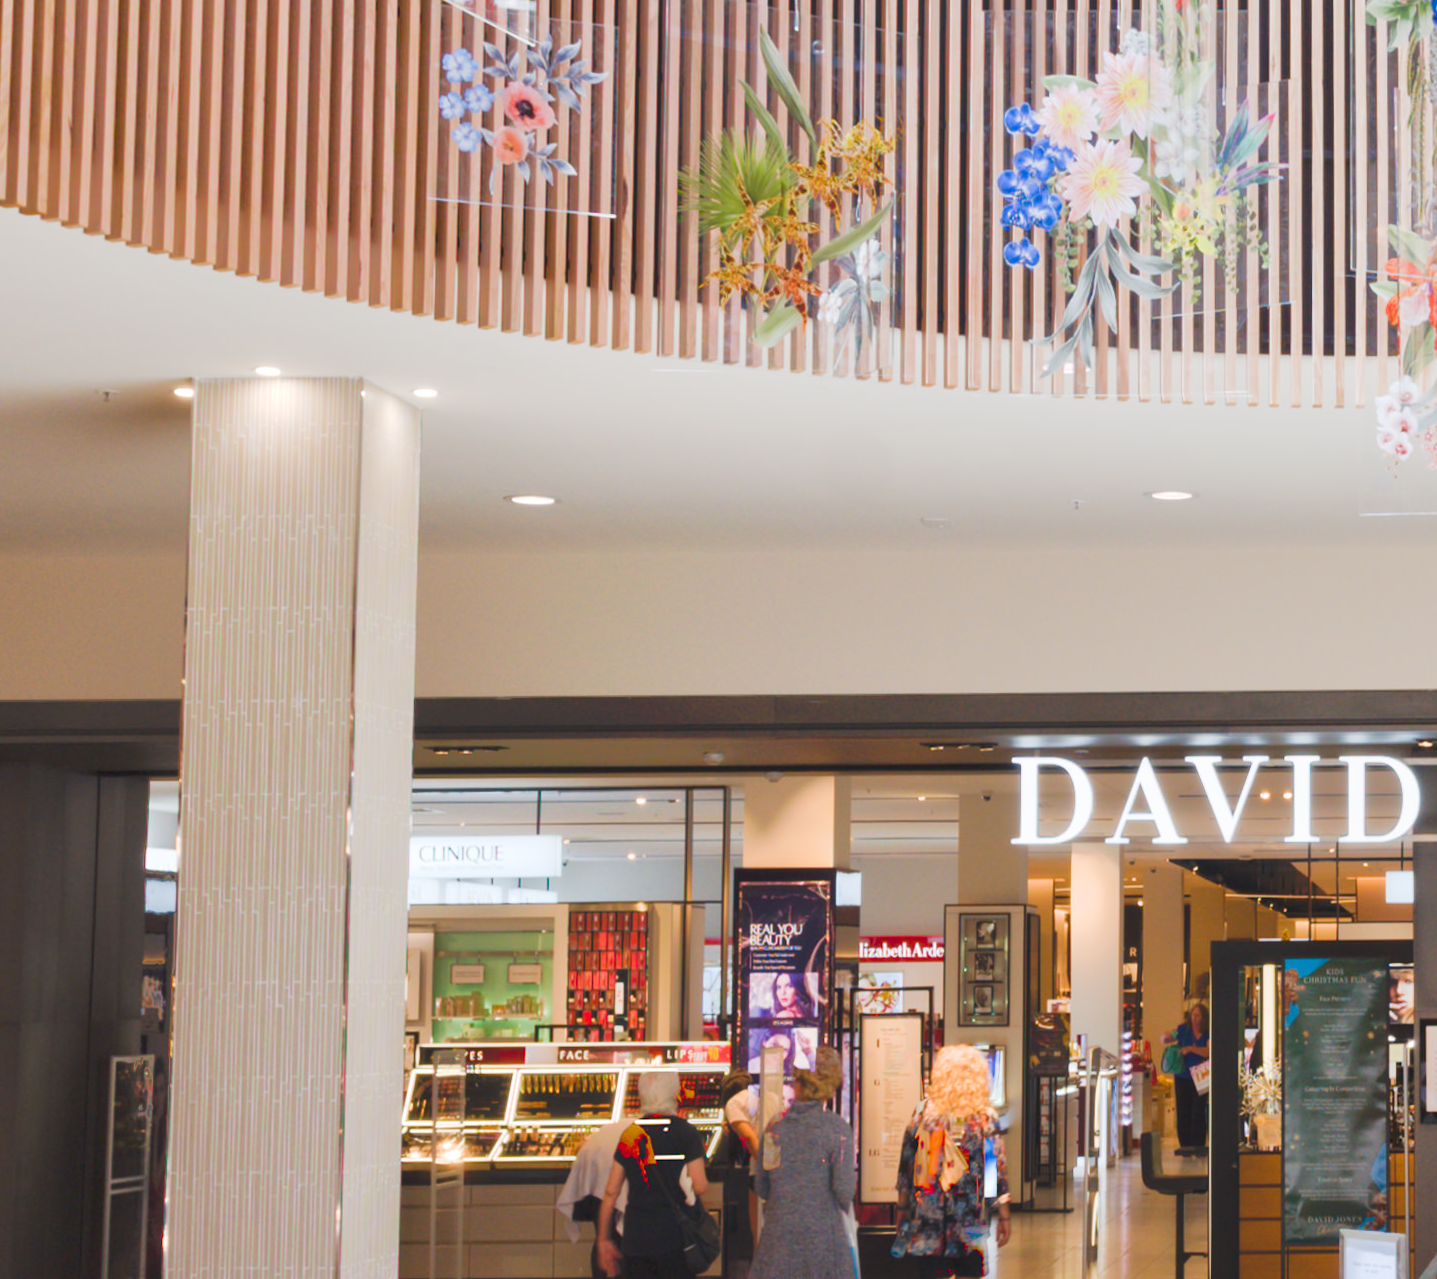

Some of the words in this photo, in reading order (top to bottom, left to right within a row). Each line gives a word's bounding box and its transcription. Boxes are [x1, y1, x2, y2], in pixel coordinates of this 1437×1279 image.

[1010, 755, 1420, 846] DAVID
[419, 845, 505, 863] CLINIQUE
[750, 923, 776, 935] REAL
[777, 923, 803, 935] YOU
[750, 934, 793, 946] BEAUTY
[859, 942, 911, 958] lizabeth
[912, 942, 944, 958] Arde
[1303, 976, 1349, 984] CHRISTMAS
[1350, 976, 1367, 984] FUN
[559, 1050, 590, 1061] FACE
[667, 1049, 693, 1060] LIPS
